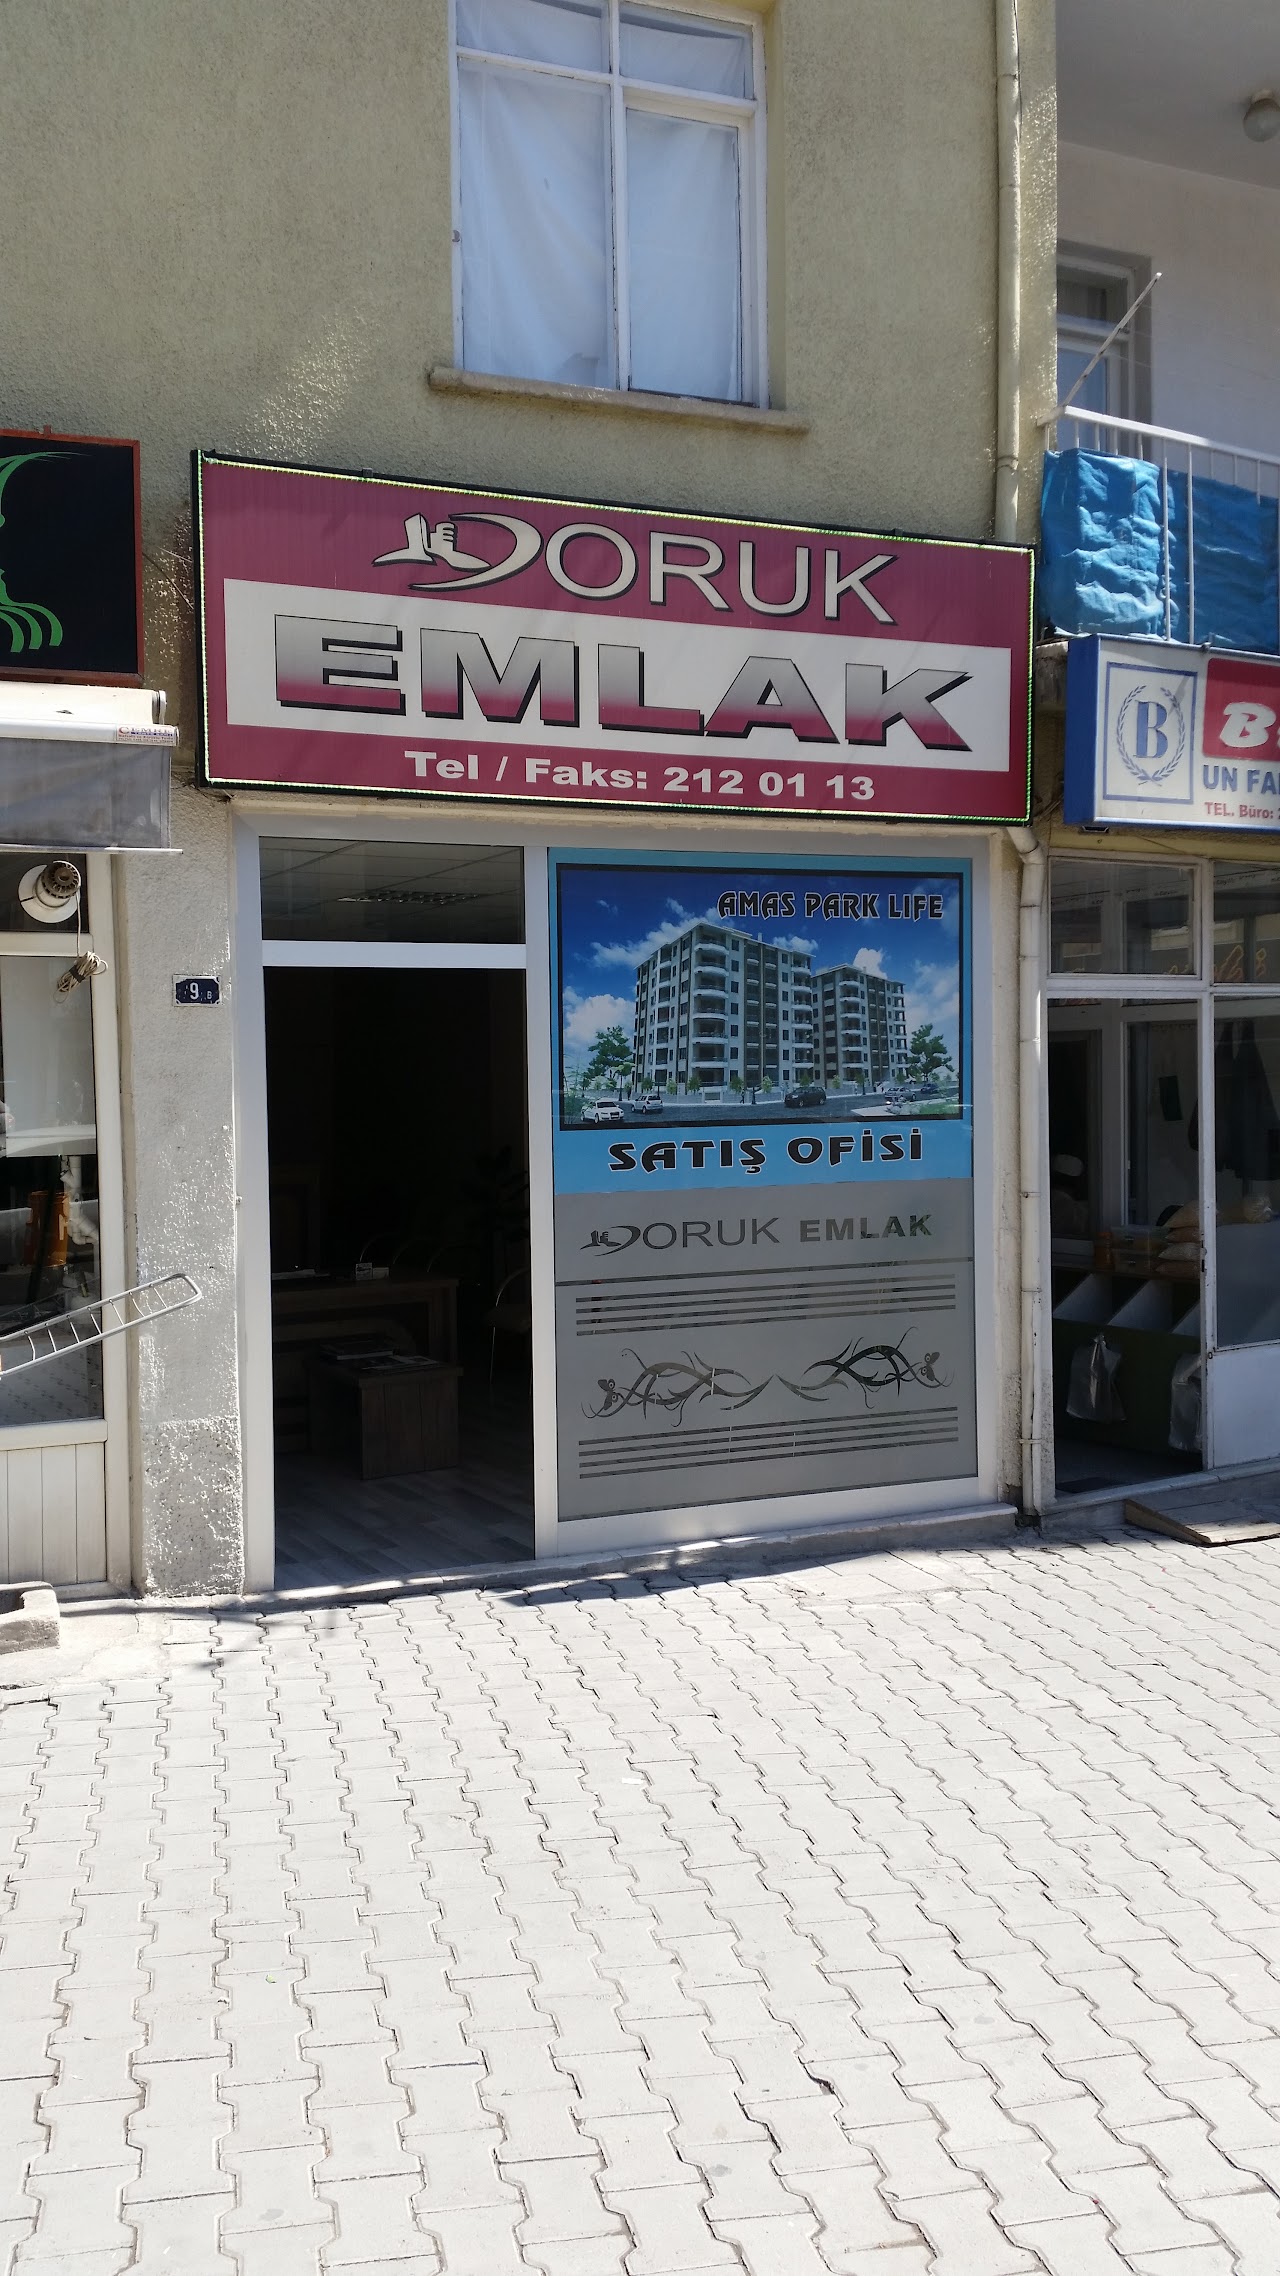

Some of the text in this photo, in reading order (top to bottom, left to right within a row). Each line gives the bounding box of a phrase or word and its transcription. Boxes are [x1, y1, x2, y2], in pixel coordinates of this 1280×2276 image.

[274, 613, 973, 753] EMLAK
[1133, 699, 1169, 759] B
[1219, 701, 1280, 749] B
[404, 750, 876, 801] Tel / Faks: 212 01 13
[1202, 764, 1280, 795] UN FA
[1204, 801, 1235, 817] TEL.
[1239, 804, 1274, 820] Büro:
[717, 889, 945, 922] AMAS PARK LIFE
[189, 982, 213, 1000] 9 B
[607, 1128, 924, 1175] SATIŞ OFİSİ
[798, 1213, 933, 1243] EMLAK
